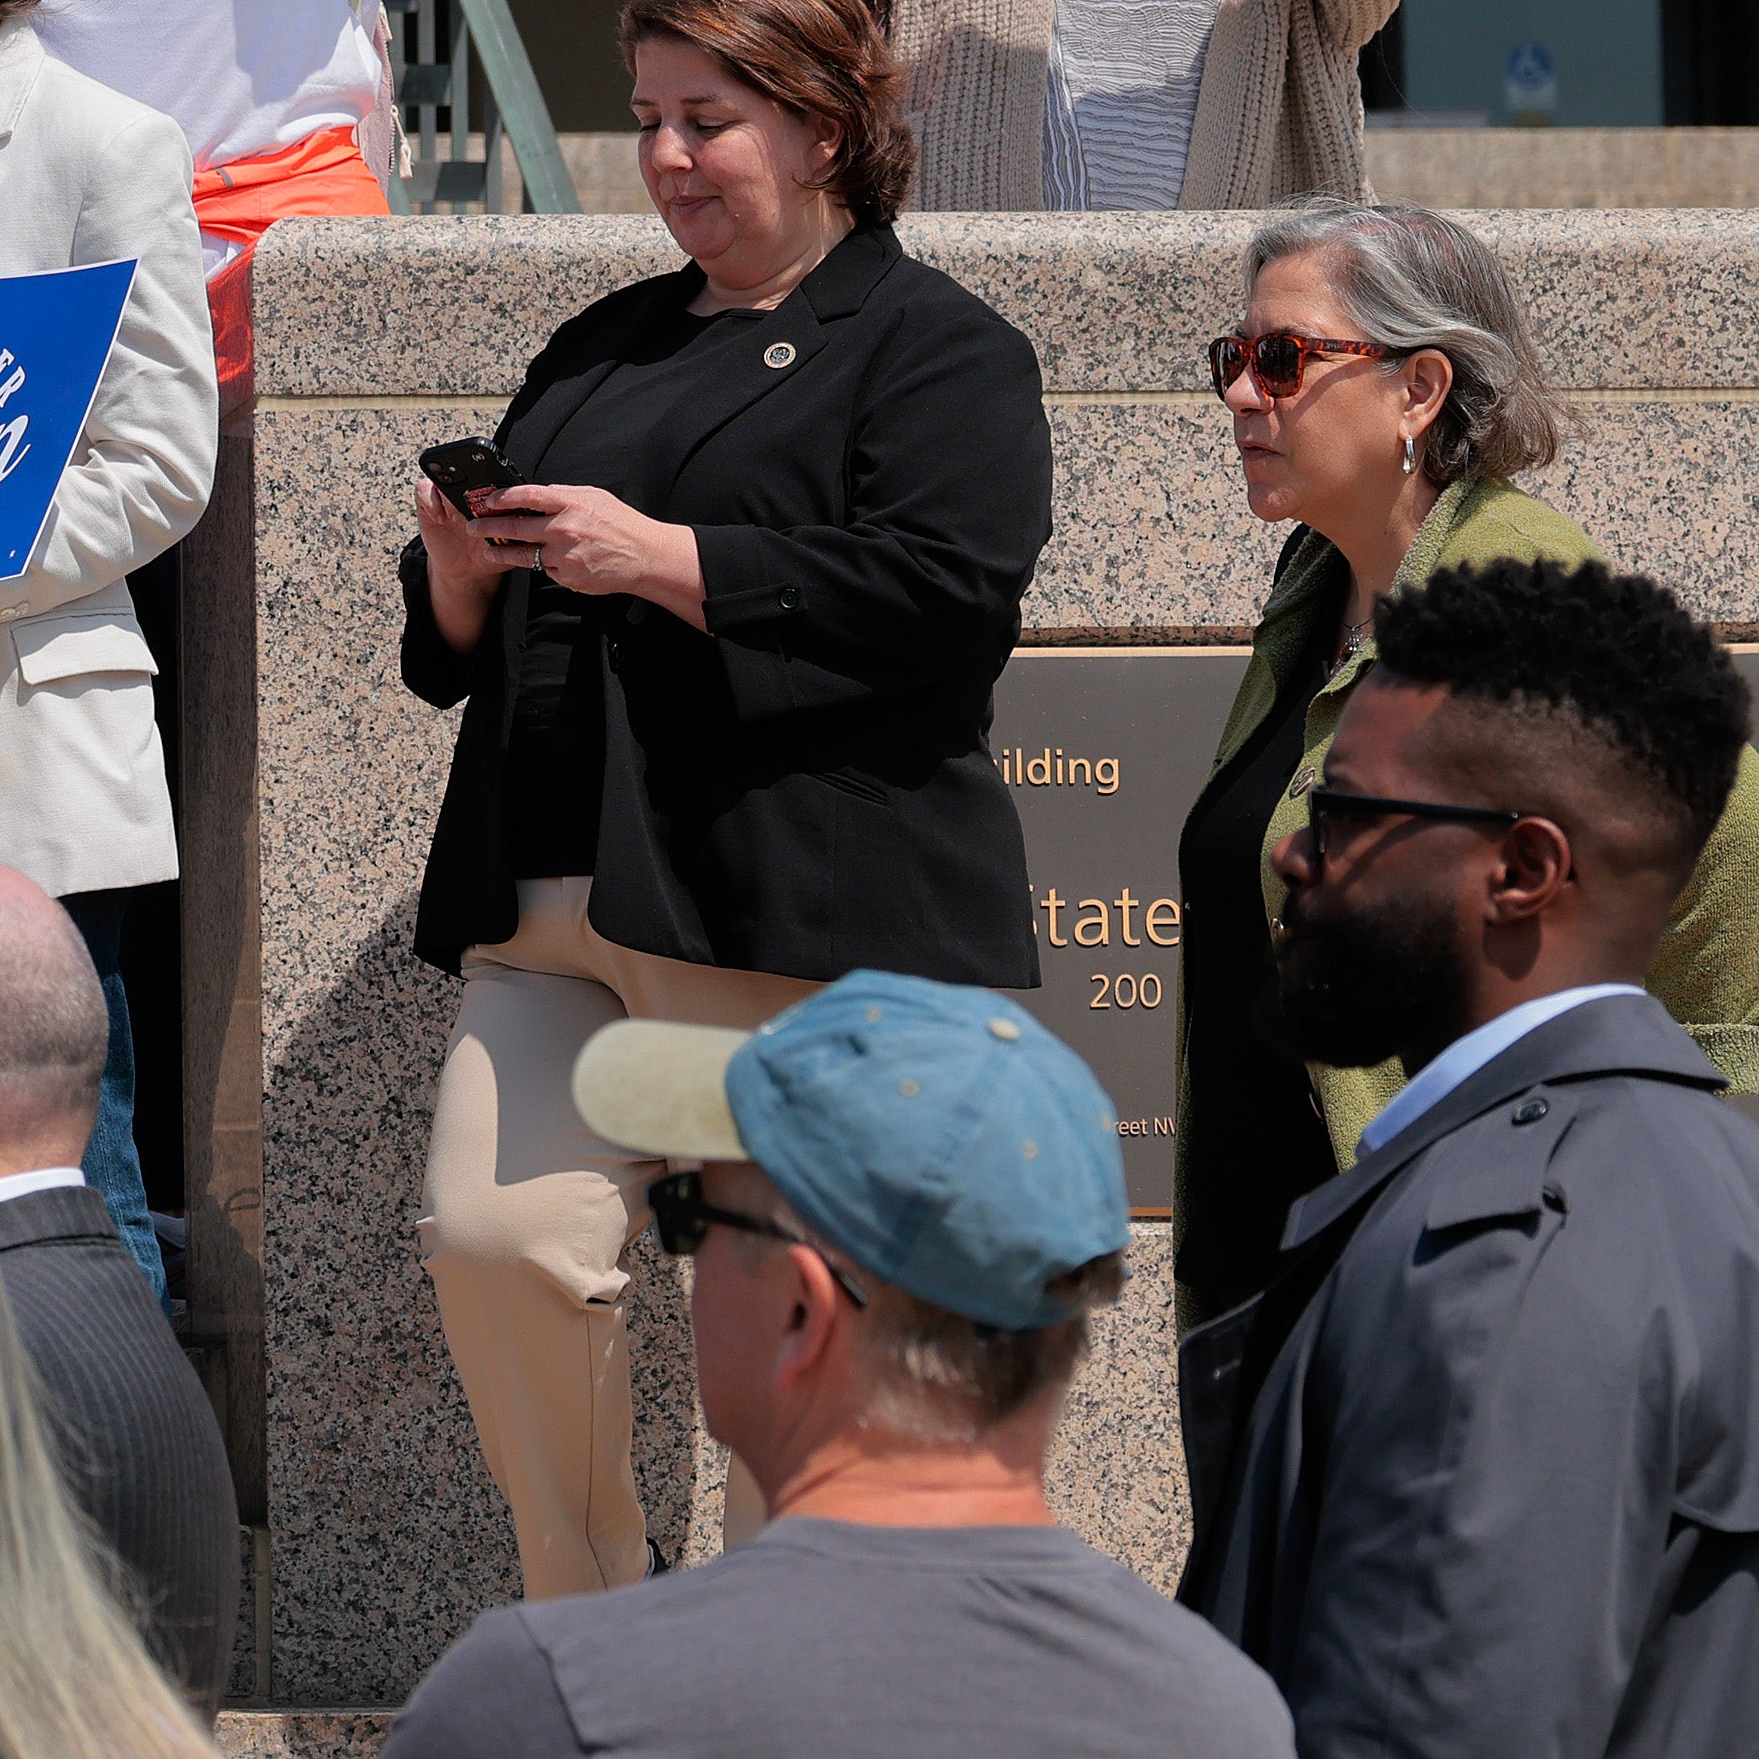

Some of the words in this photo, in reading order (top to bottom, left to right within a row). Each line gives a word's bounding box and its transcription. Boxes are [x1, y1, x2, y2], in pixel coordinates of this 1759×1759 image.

[995, 748, 1121, 794] ilding
[1030, 884, 1181, 946] tate
[1089, 973, 1163, 1009] 200
[1114, 1118, 1149, 1136] reet
